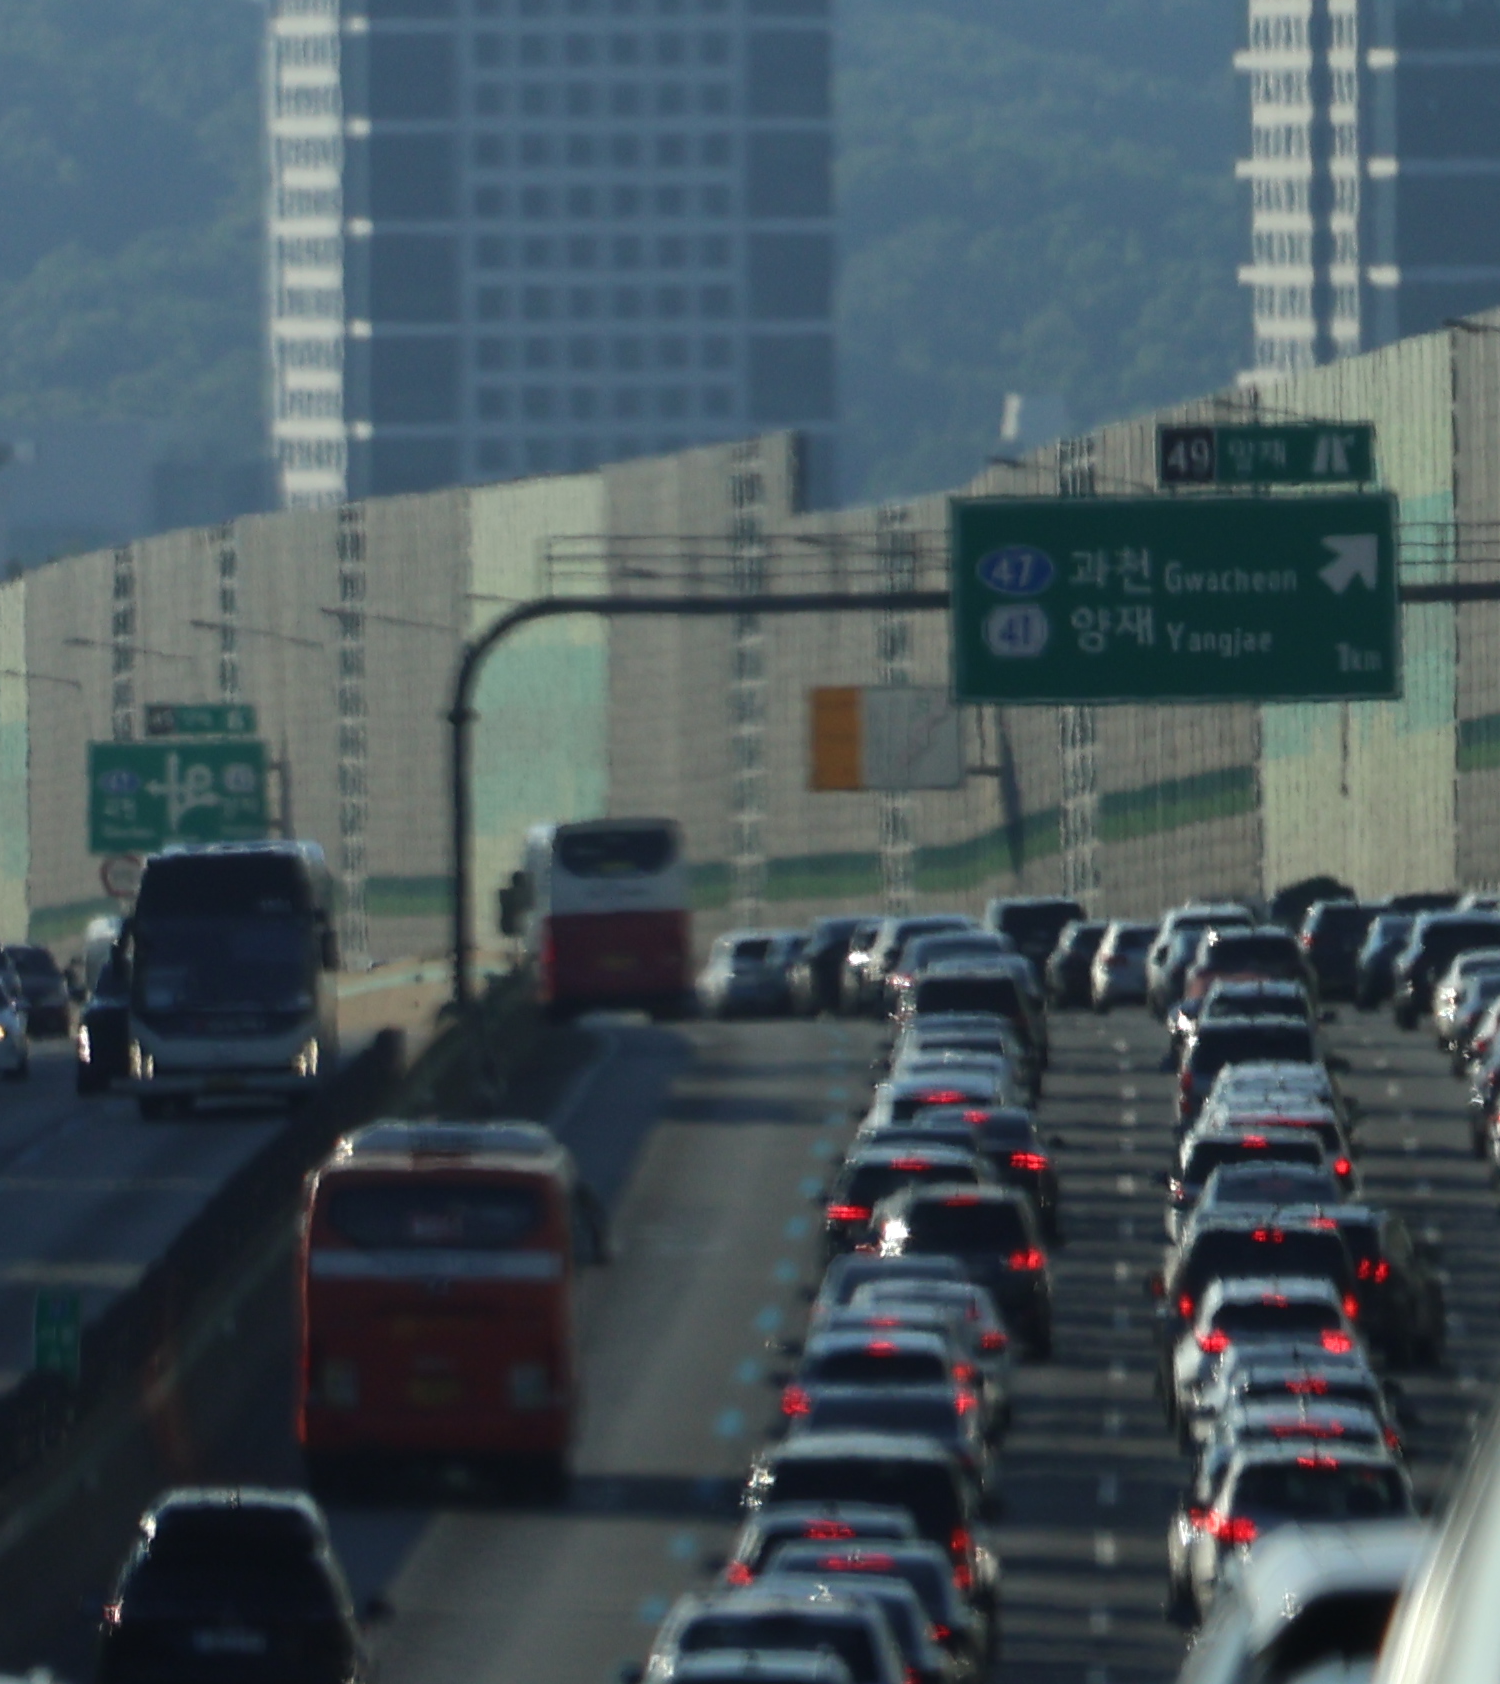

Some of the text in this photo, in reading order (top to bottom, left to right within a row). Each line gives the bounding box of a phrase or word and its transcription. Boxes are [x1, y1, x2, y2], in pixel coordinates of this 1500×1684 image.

[1167, 438, 1210, 476] 49
[990, 546, 1298, 595] 47 과천 Gwacheon
[1069, 604, 1157, 653] 양재
[1166, 624, 1274, 658] Yangjae
